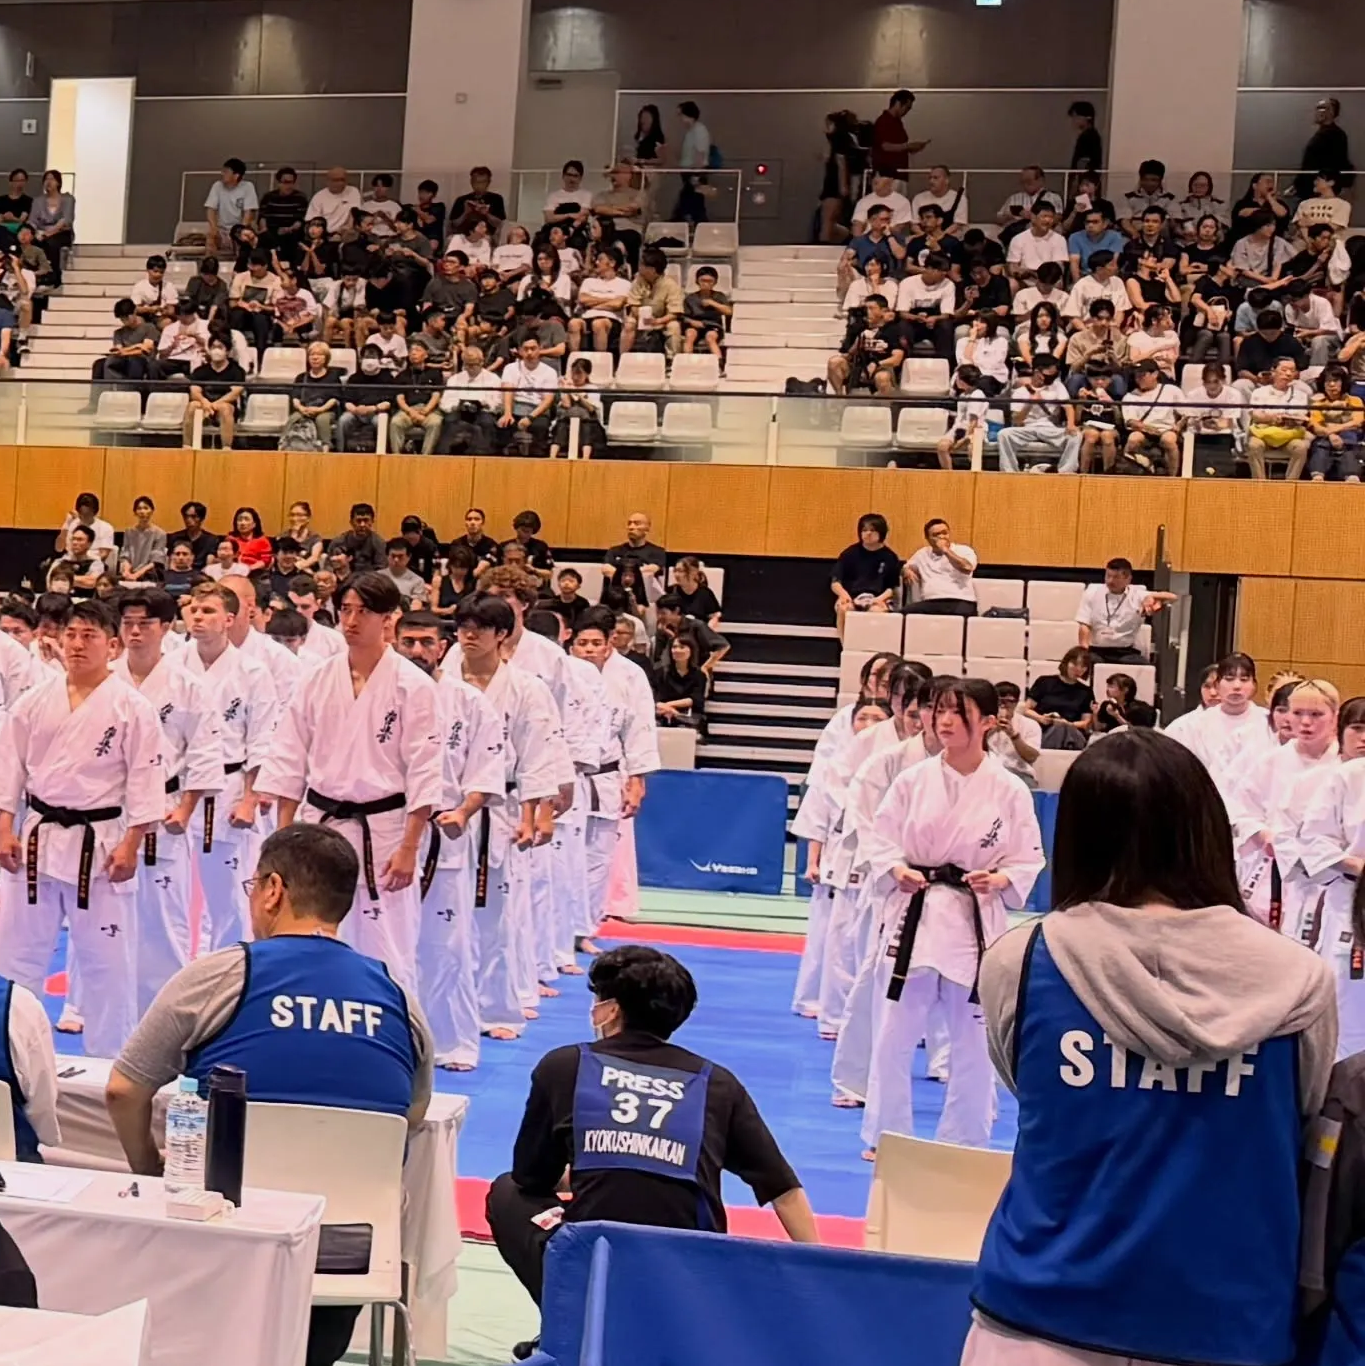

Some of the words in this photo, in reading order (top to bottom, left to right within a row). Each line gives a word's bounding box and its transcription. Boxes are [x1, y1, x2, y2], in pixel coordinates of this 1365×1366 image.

[269, 994, 384, 1037] STAFF
[601, 1065, 686, 1101] PRESS
[610, 1091, 674, 1129] 37
[583, 1129, 687, 1167] KYOKUSHINKAIKAN
